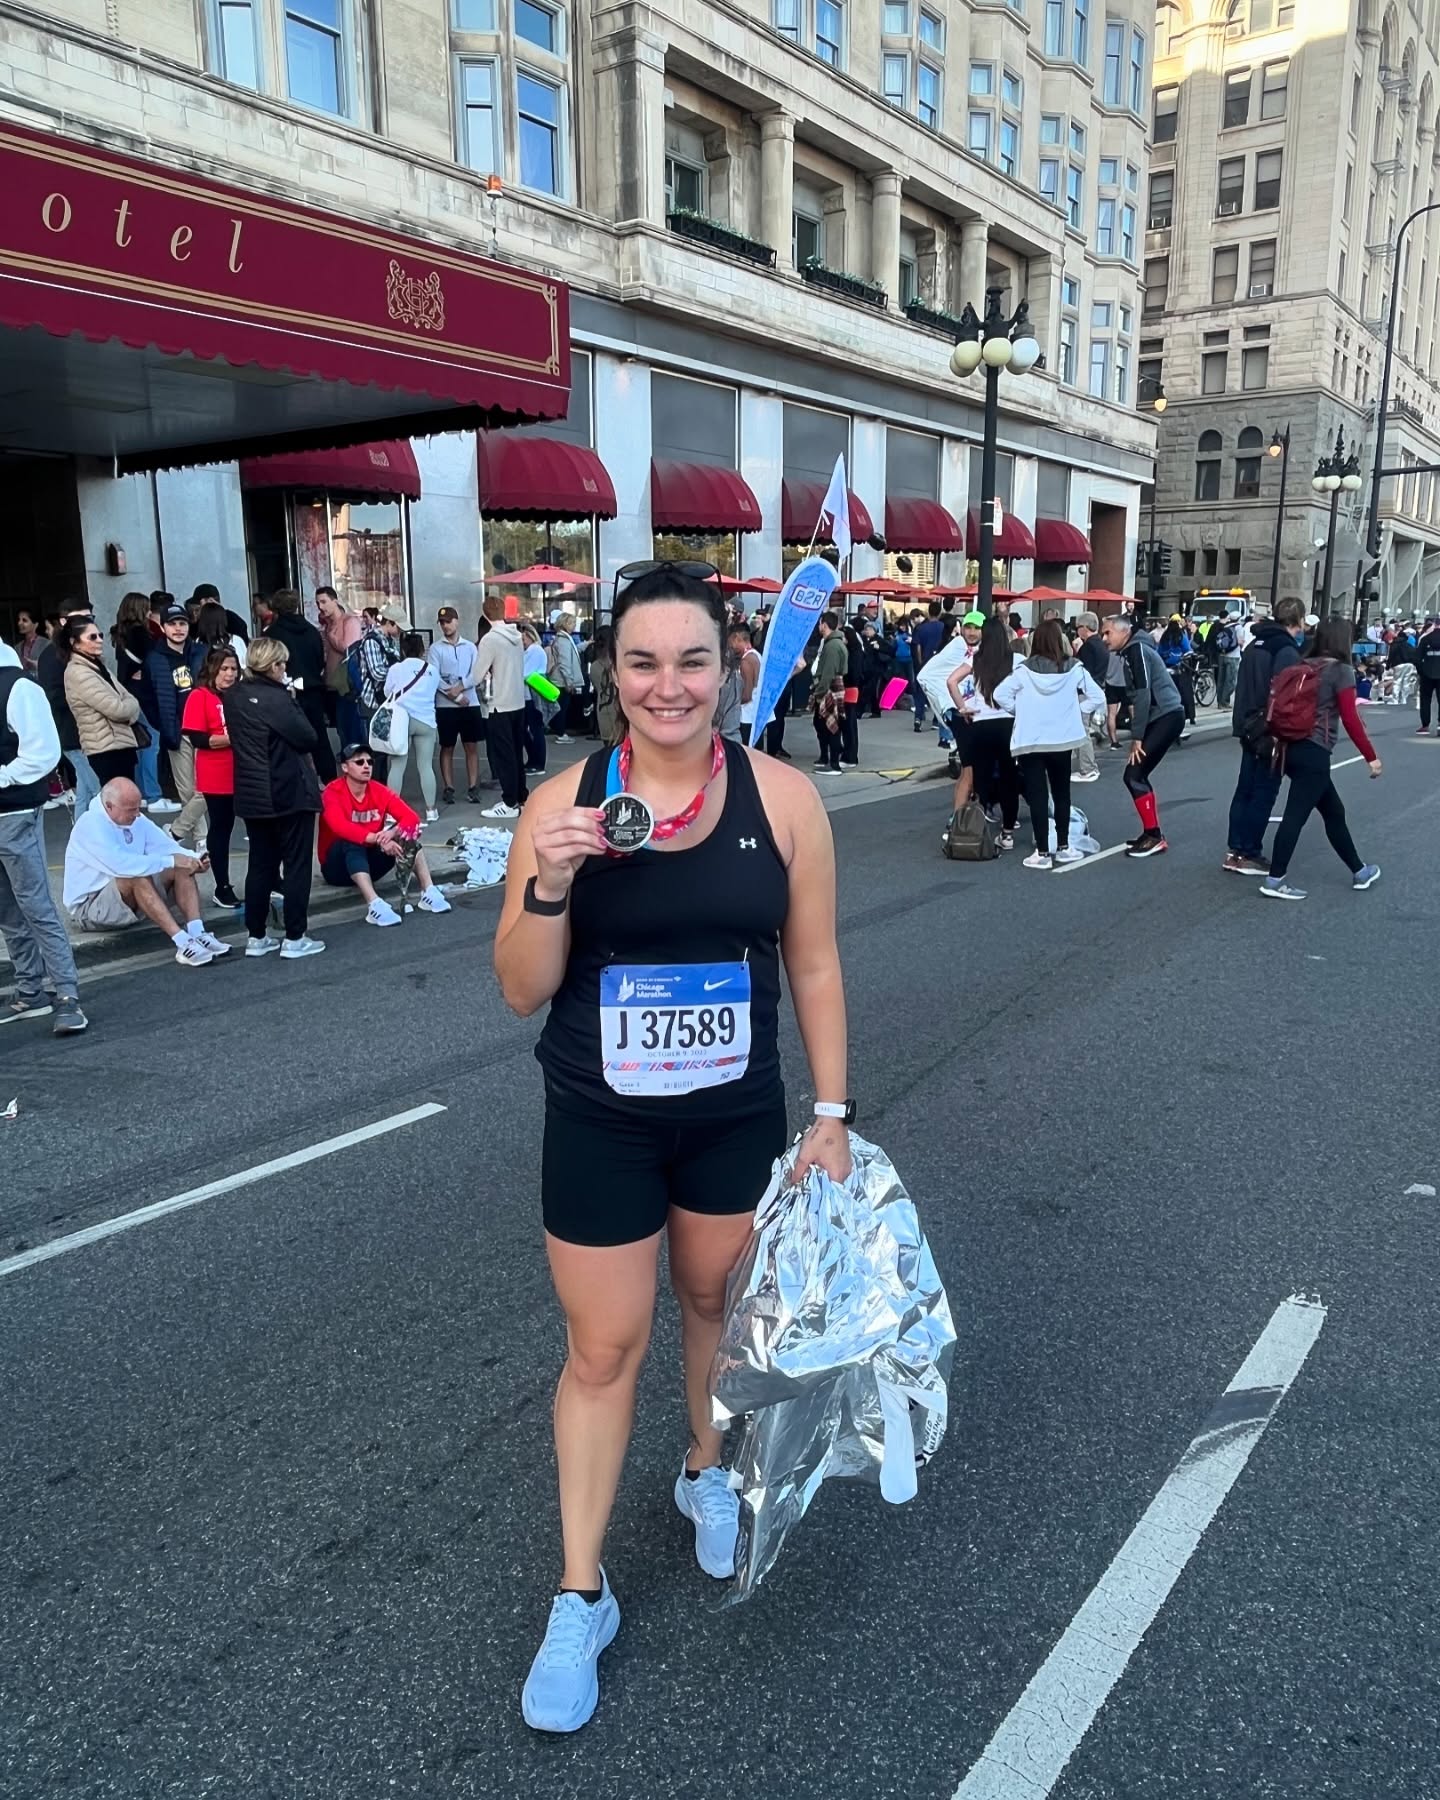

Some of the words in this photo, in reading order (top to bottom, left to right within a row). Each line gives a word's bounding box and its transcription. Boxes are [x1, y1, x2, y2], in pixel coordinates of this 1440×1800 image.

[795, 590, 821, 605] B2R
[636, 983, 665, 992] Chicago
[637, 990, 673, 998] Marathon
[617, 1011, 628, 1049] J
[641, 1007, 735, 1049] 37589
[929, 1413, 943, 1450] MARATHO
